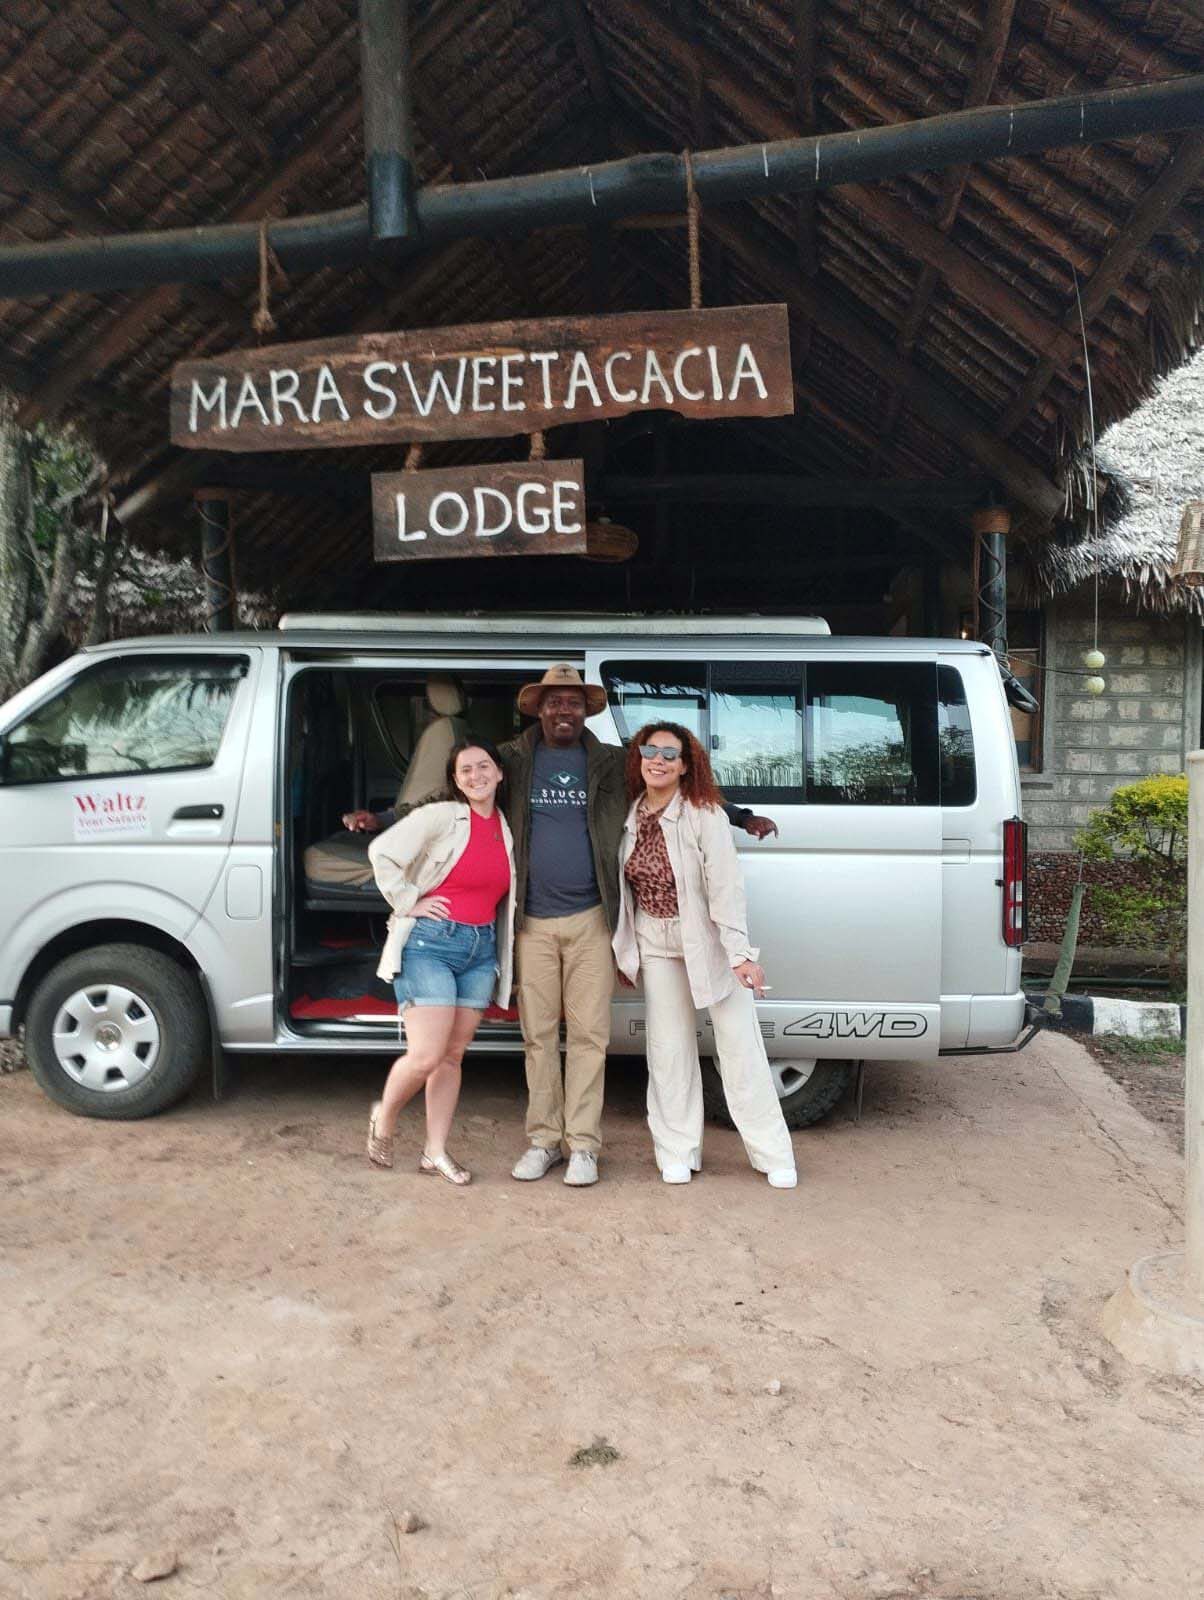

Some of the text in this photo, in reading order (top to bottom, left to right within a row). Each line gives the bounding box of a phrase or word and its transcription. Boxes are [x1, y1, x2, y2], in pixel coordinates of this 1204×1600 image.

[189, 365, 351, 432] MARA
[396, 480, 583, 542] LODGE
[73, 791, 147, 813] Waltz
[541, 788, 587, 799] STUCO
[783, 1011, 928, 1039] 4WD
